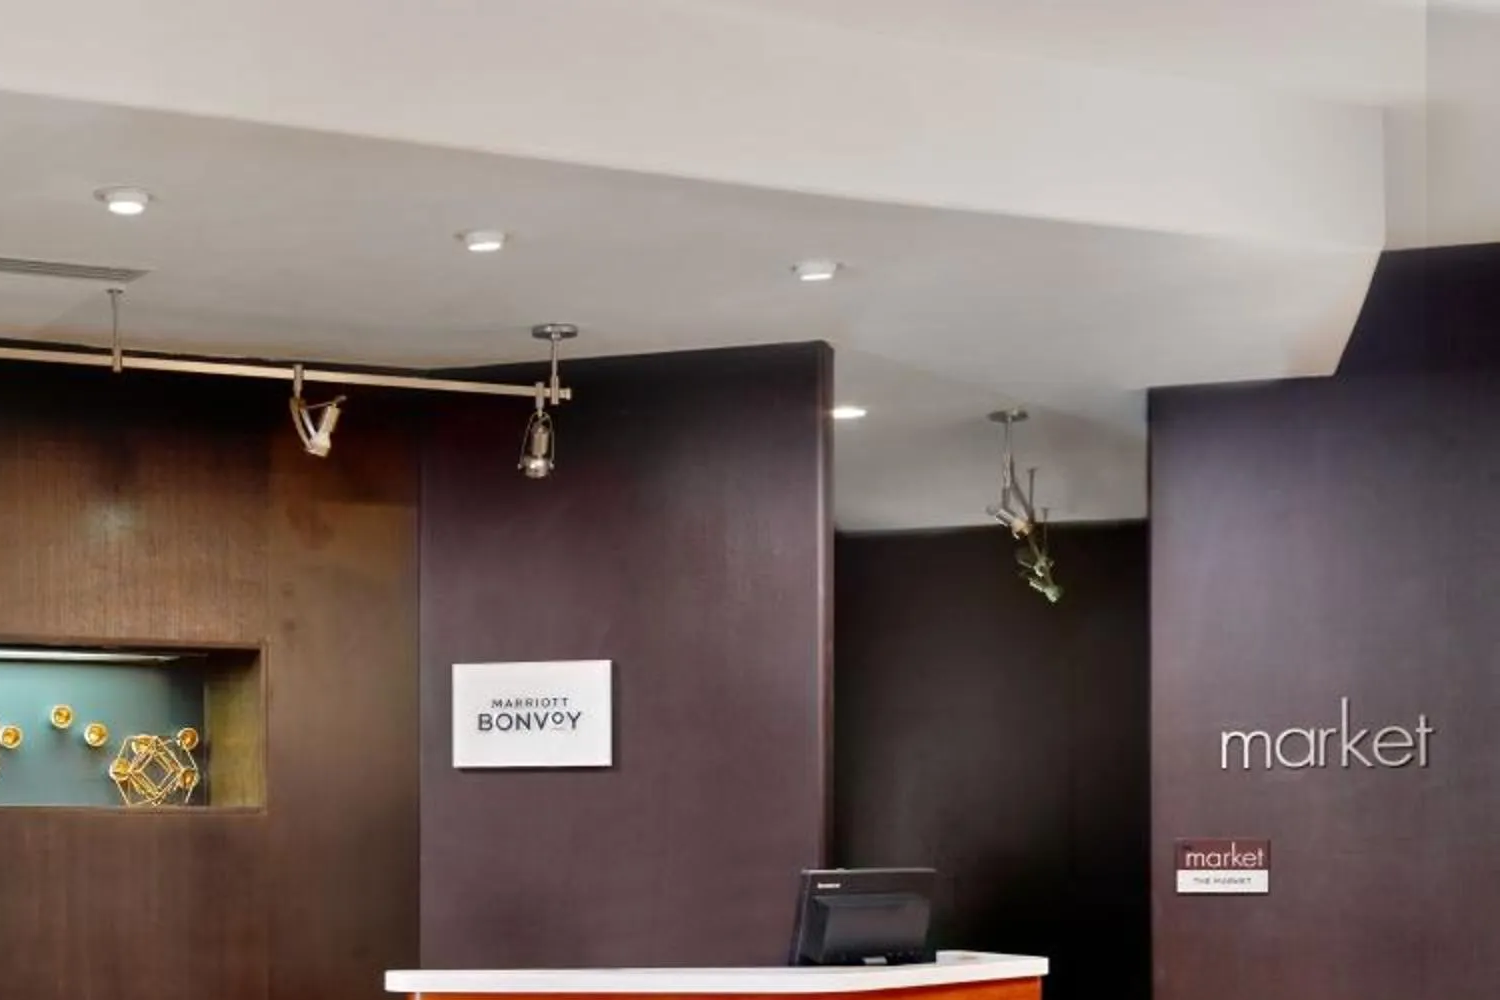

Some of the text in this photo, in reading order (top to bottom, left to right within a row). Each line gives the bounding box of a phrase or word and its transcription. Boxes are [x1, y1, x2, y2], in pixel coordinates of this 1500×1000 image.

[491, 697, 569, 708] MARRIOTT
[477, 711, 582, 731] BONVOY
[1220, 696, 1434, 769] market
[1185, 841, 1264, 867] market
